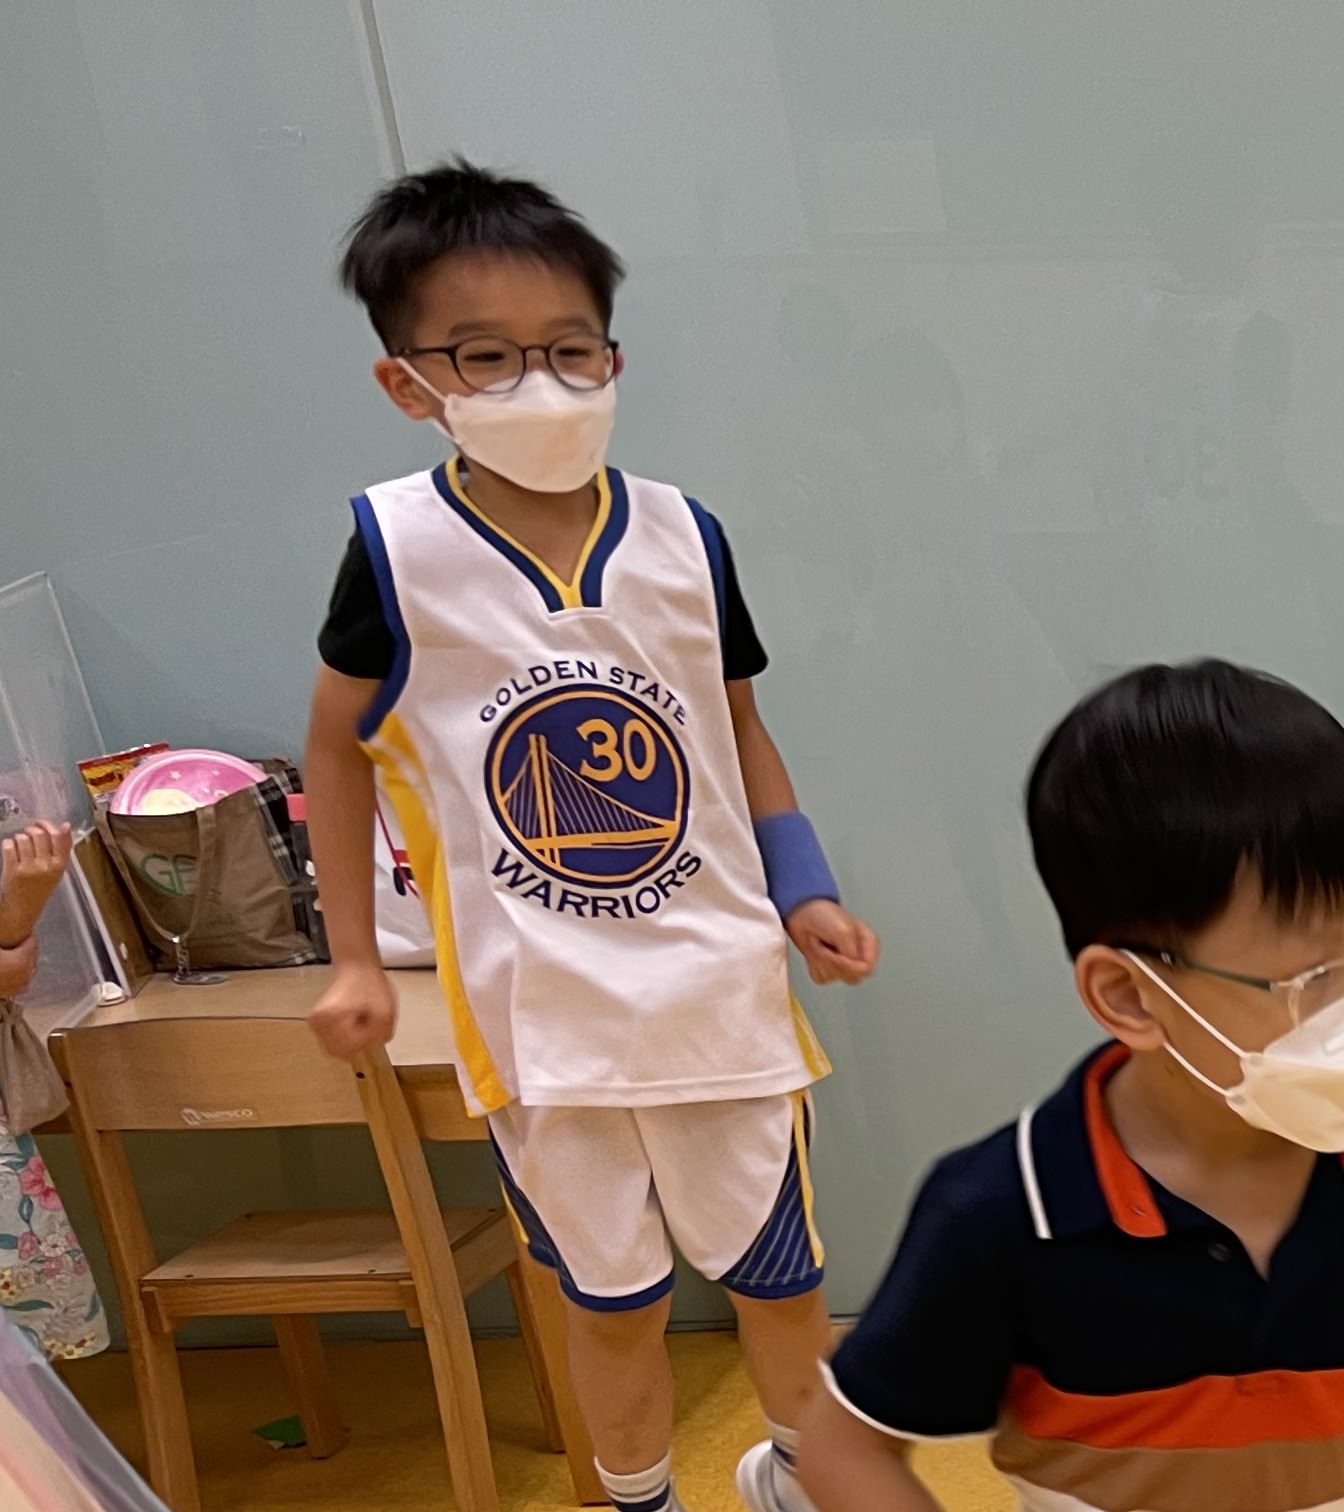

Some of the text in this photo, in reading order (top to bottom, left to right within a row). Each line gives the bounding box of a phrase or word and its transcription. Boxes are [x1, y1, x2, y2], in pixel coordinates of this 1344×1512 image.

[480, 660, 689, 726] GOLDEN STATE
[575, 717, 658, 783] 30
[491, 848, 703, 919] WARRIORS
